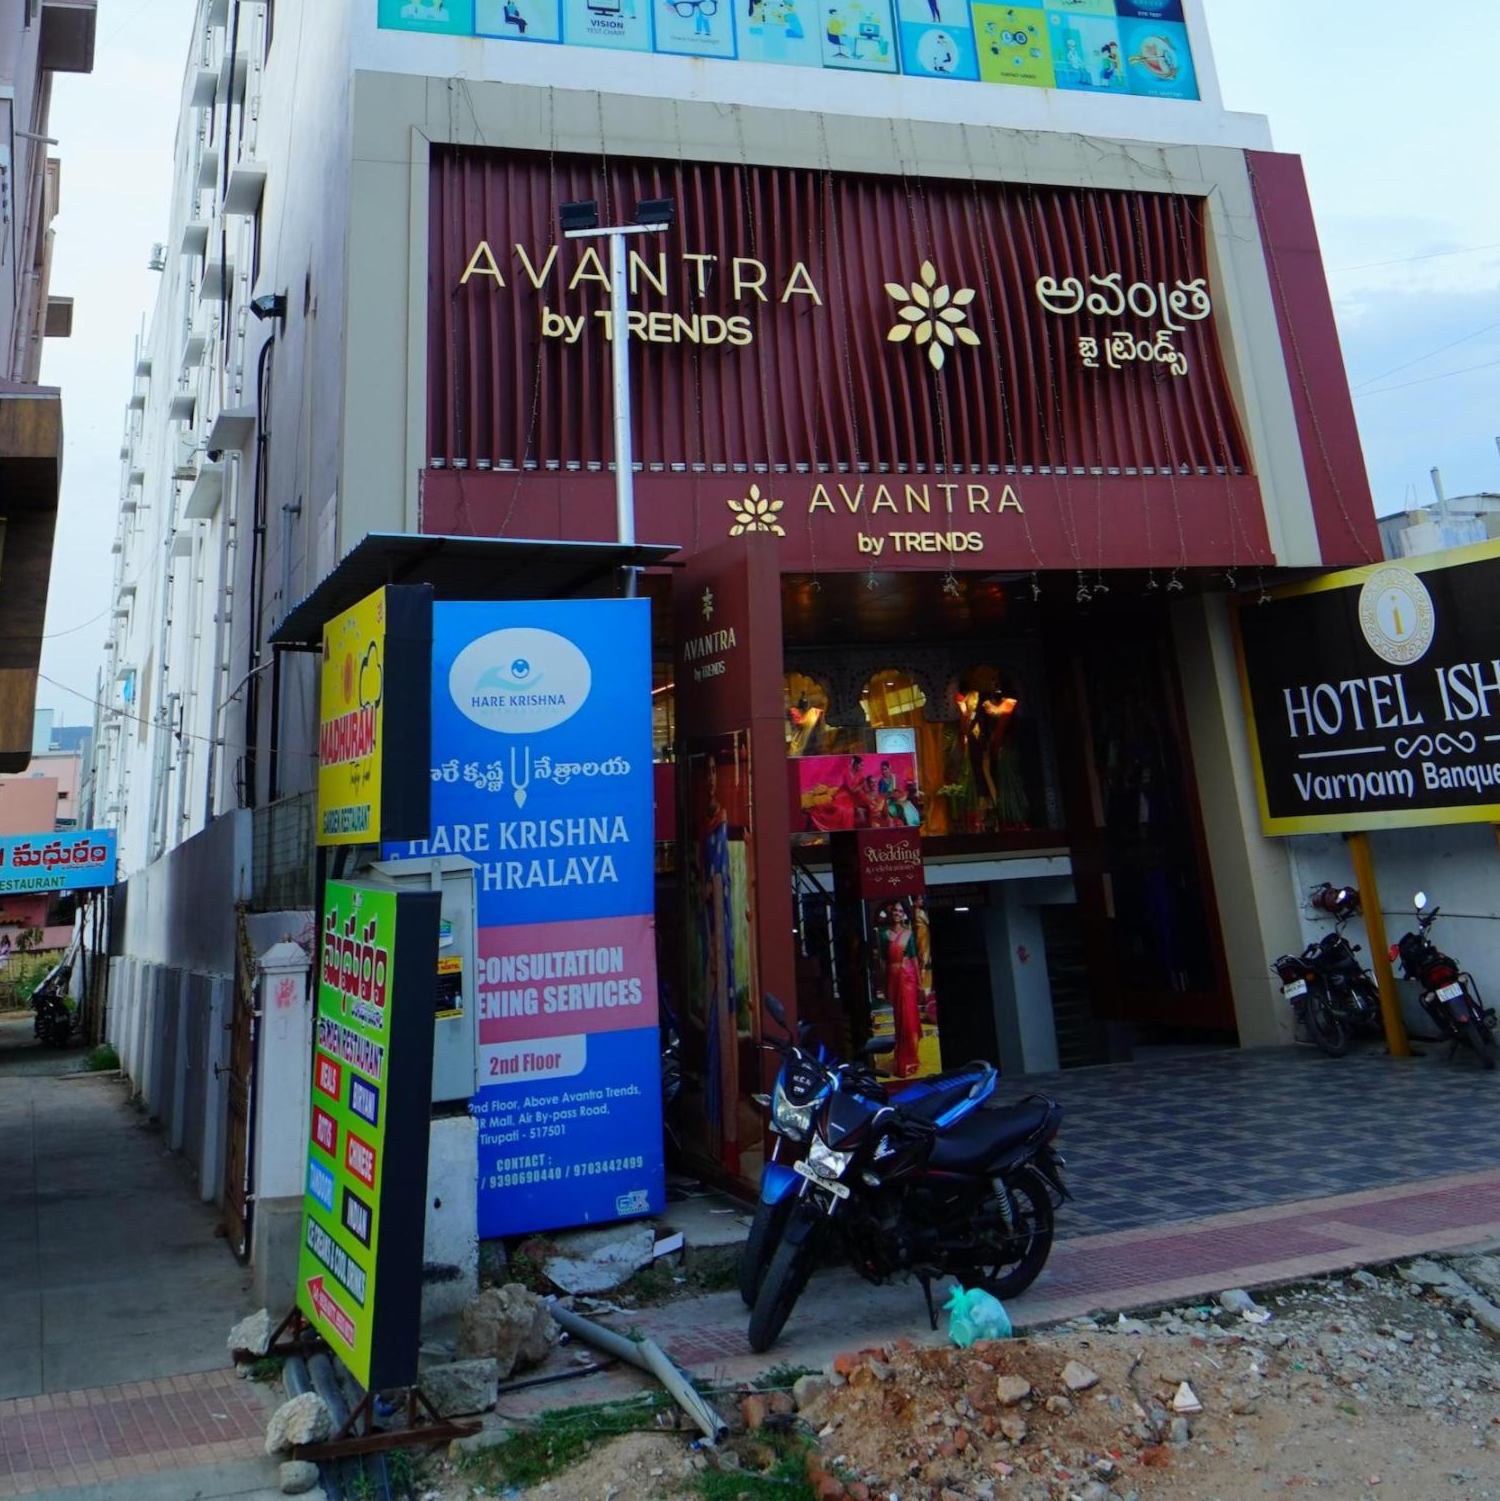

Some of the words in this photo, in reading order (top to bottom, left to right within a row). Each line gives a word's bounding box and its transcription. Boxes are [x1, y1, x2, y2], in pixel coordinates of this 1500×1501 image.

[590, 19, 624, 29] VISION
[460, 240, 823, 306] AVANTRA
[1035, 273, 1213, 331] అవంత్ర
[542, 306, 585, 344] by
[594, 310, 753, 346] TRENDS
[808, 484, 1025, 515] AVANTRA
[858, 533, 885, 556] by
[889, 532, 984, 553] TRENDS
[684, 626, 736, 662] AVANTRA
[471, 696, 506, 708] HARE
[510, 694, 566, 707] KRISHNA
[1283, 673, 1424, 738] HOTEL
[320, 705, 375, 766] MADHURAM
[463, 759, 505, 792] కృష్ణ
[1293, 767, 1415, 802] Varnam
[500, 815, 630, 849] KRISHNA
[863, 839, 921, 866] Wedding
[543, 977, 643, 1014] SERVICES
[342, 1027, 384, 1081] RESTAURANT
[490, 1055, 520, 1076] 2nd
[523, 1051, 562, 1073] Floor
[468, 1101, 489, 1114] 2nd
[523, 1095, 559, 1109] Above
[562, 1090, 603, 1104] Avantra
[518, 1113, 533, 1124] Air
[535, 1109, 577, 1124] By-pass
[480, 1129, 520, 1146] Tirupati
[529, 1124, 566, 1139] 517501
[347, 1136, 374, 1183] CHINESE
[496, 1153, 546, 1173] CONTACT
[573, 1155, 644, 1178] 9703442499
